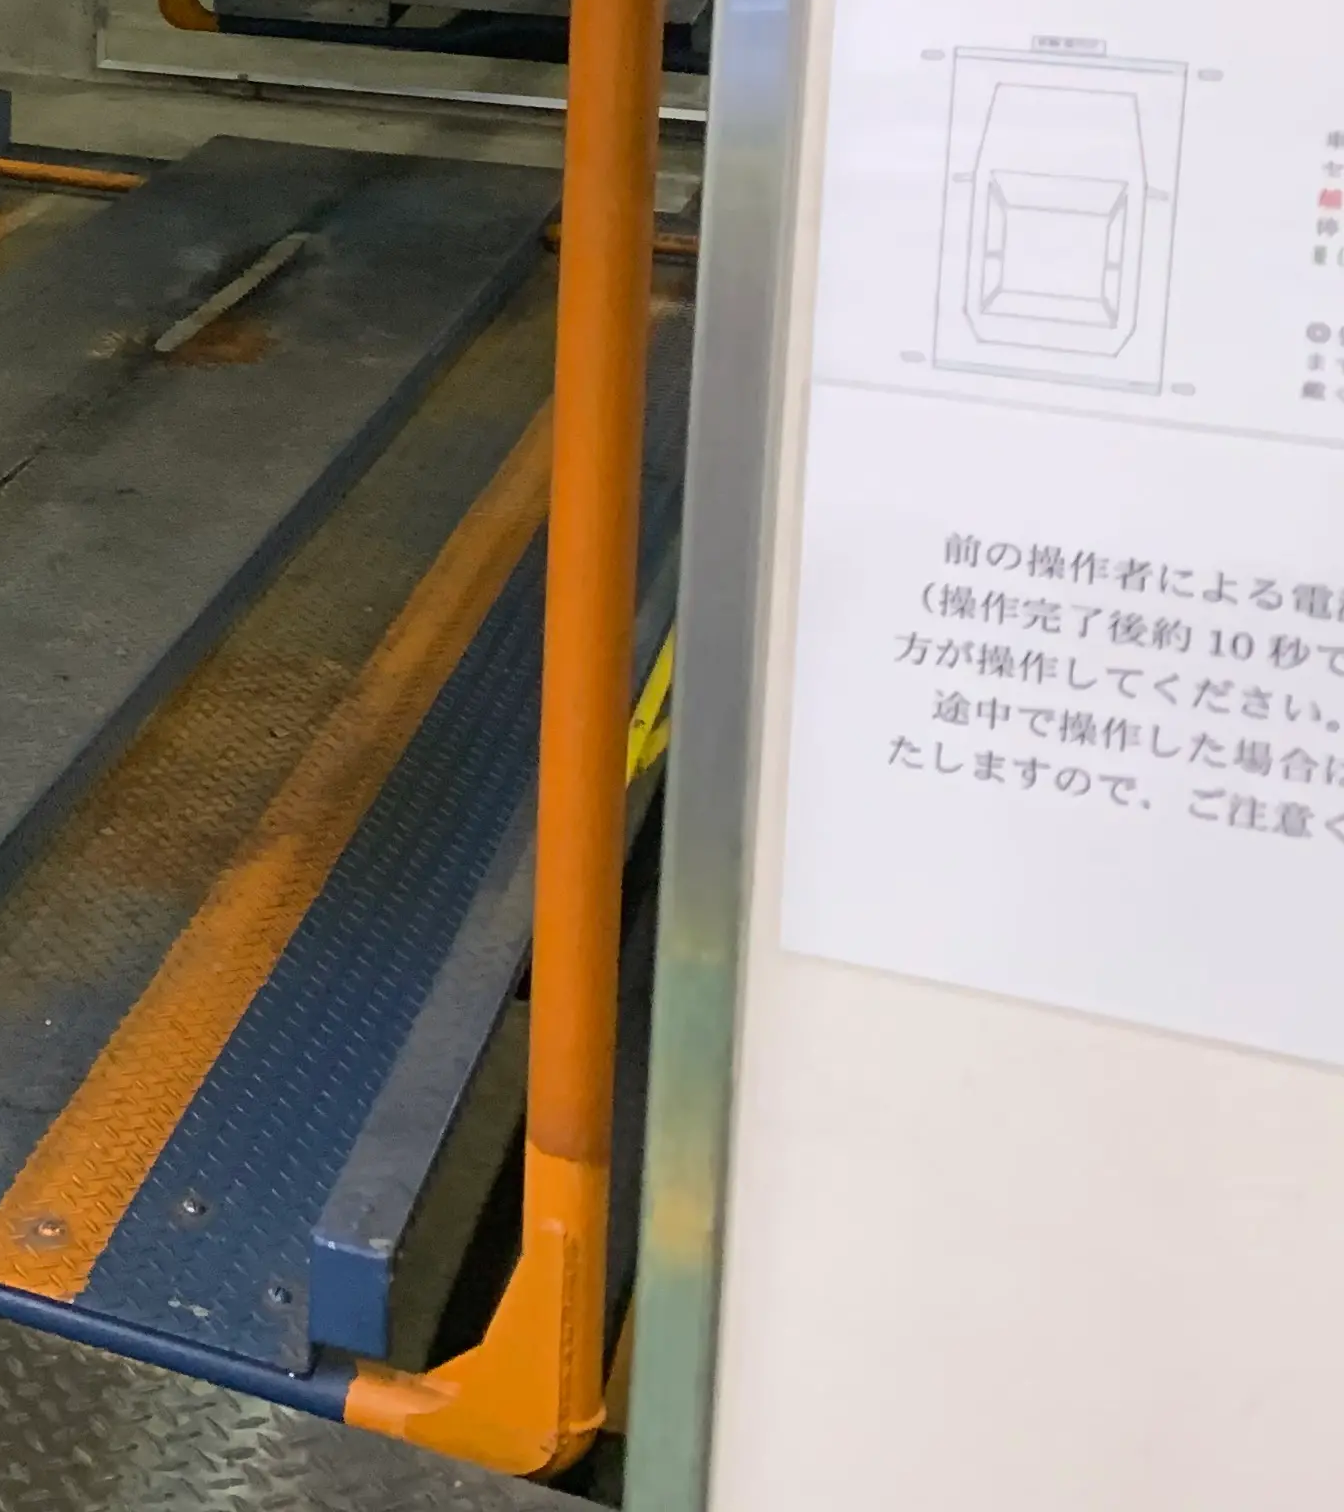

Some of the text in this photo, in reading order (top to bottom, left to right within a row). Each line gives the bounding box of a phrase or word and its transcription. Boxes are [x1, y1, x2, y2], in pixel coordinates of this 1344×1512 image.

[942, 531, 1344, 625] 前の操作者による電
